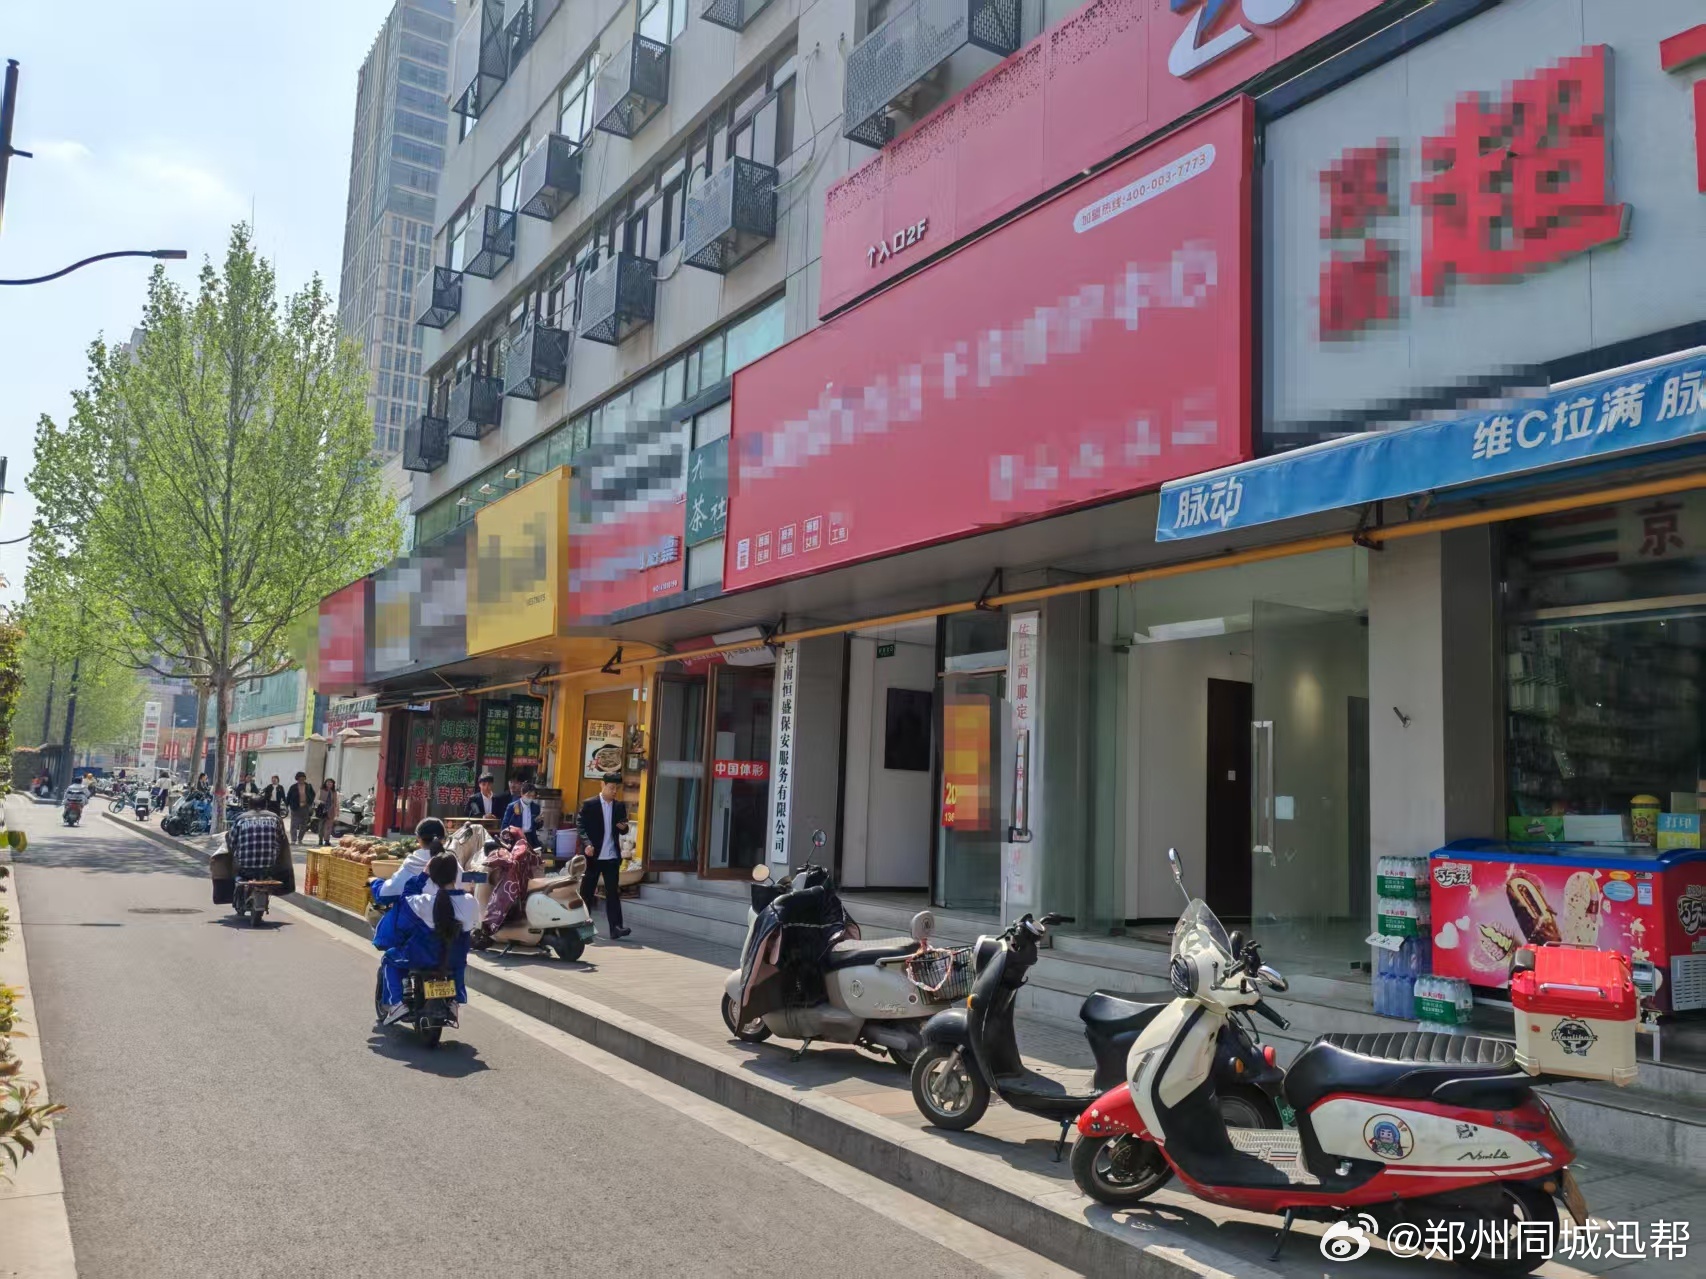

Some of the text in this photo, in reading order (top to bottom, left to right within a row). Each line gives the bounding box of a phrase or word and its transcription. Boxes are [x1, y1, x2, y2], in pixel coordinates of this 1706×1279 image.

[879, 218, 927, 264] 入口2F
[1472, 383, 1646, 459] 维C拉满
[1173, 476, 1243, 528] 脉动
[715, 762, 764, 776] 中国体彩
[774, 648, 795, 853] 河南恒盛保安服务有限公司
[1665, 815, 1692, 829] 打印
